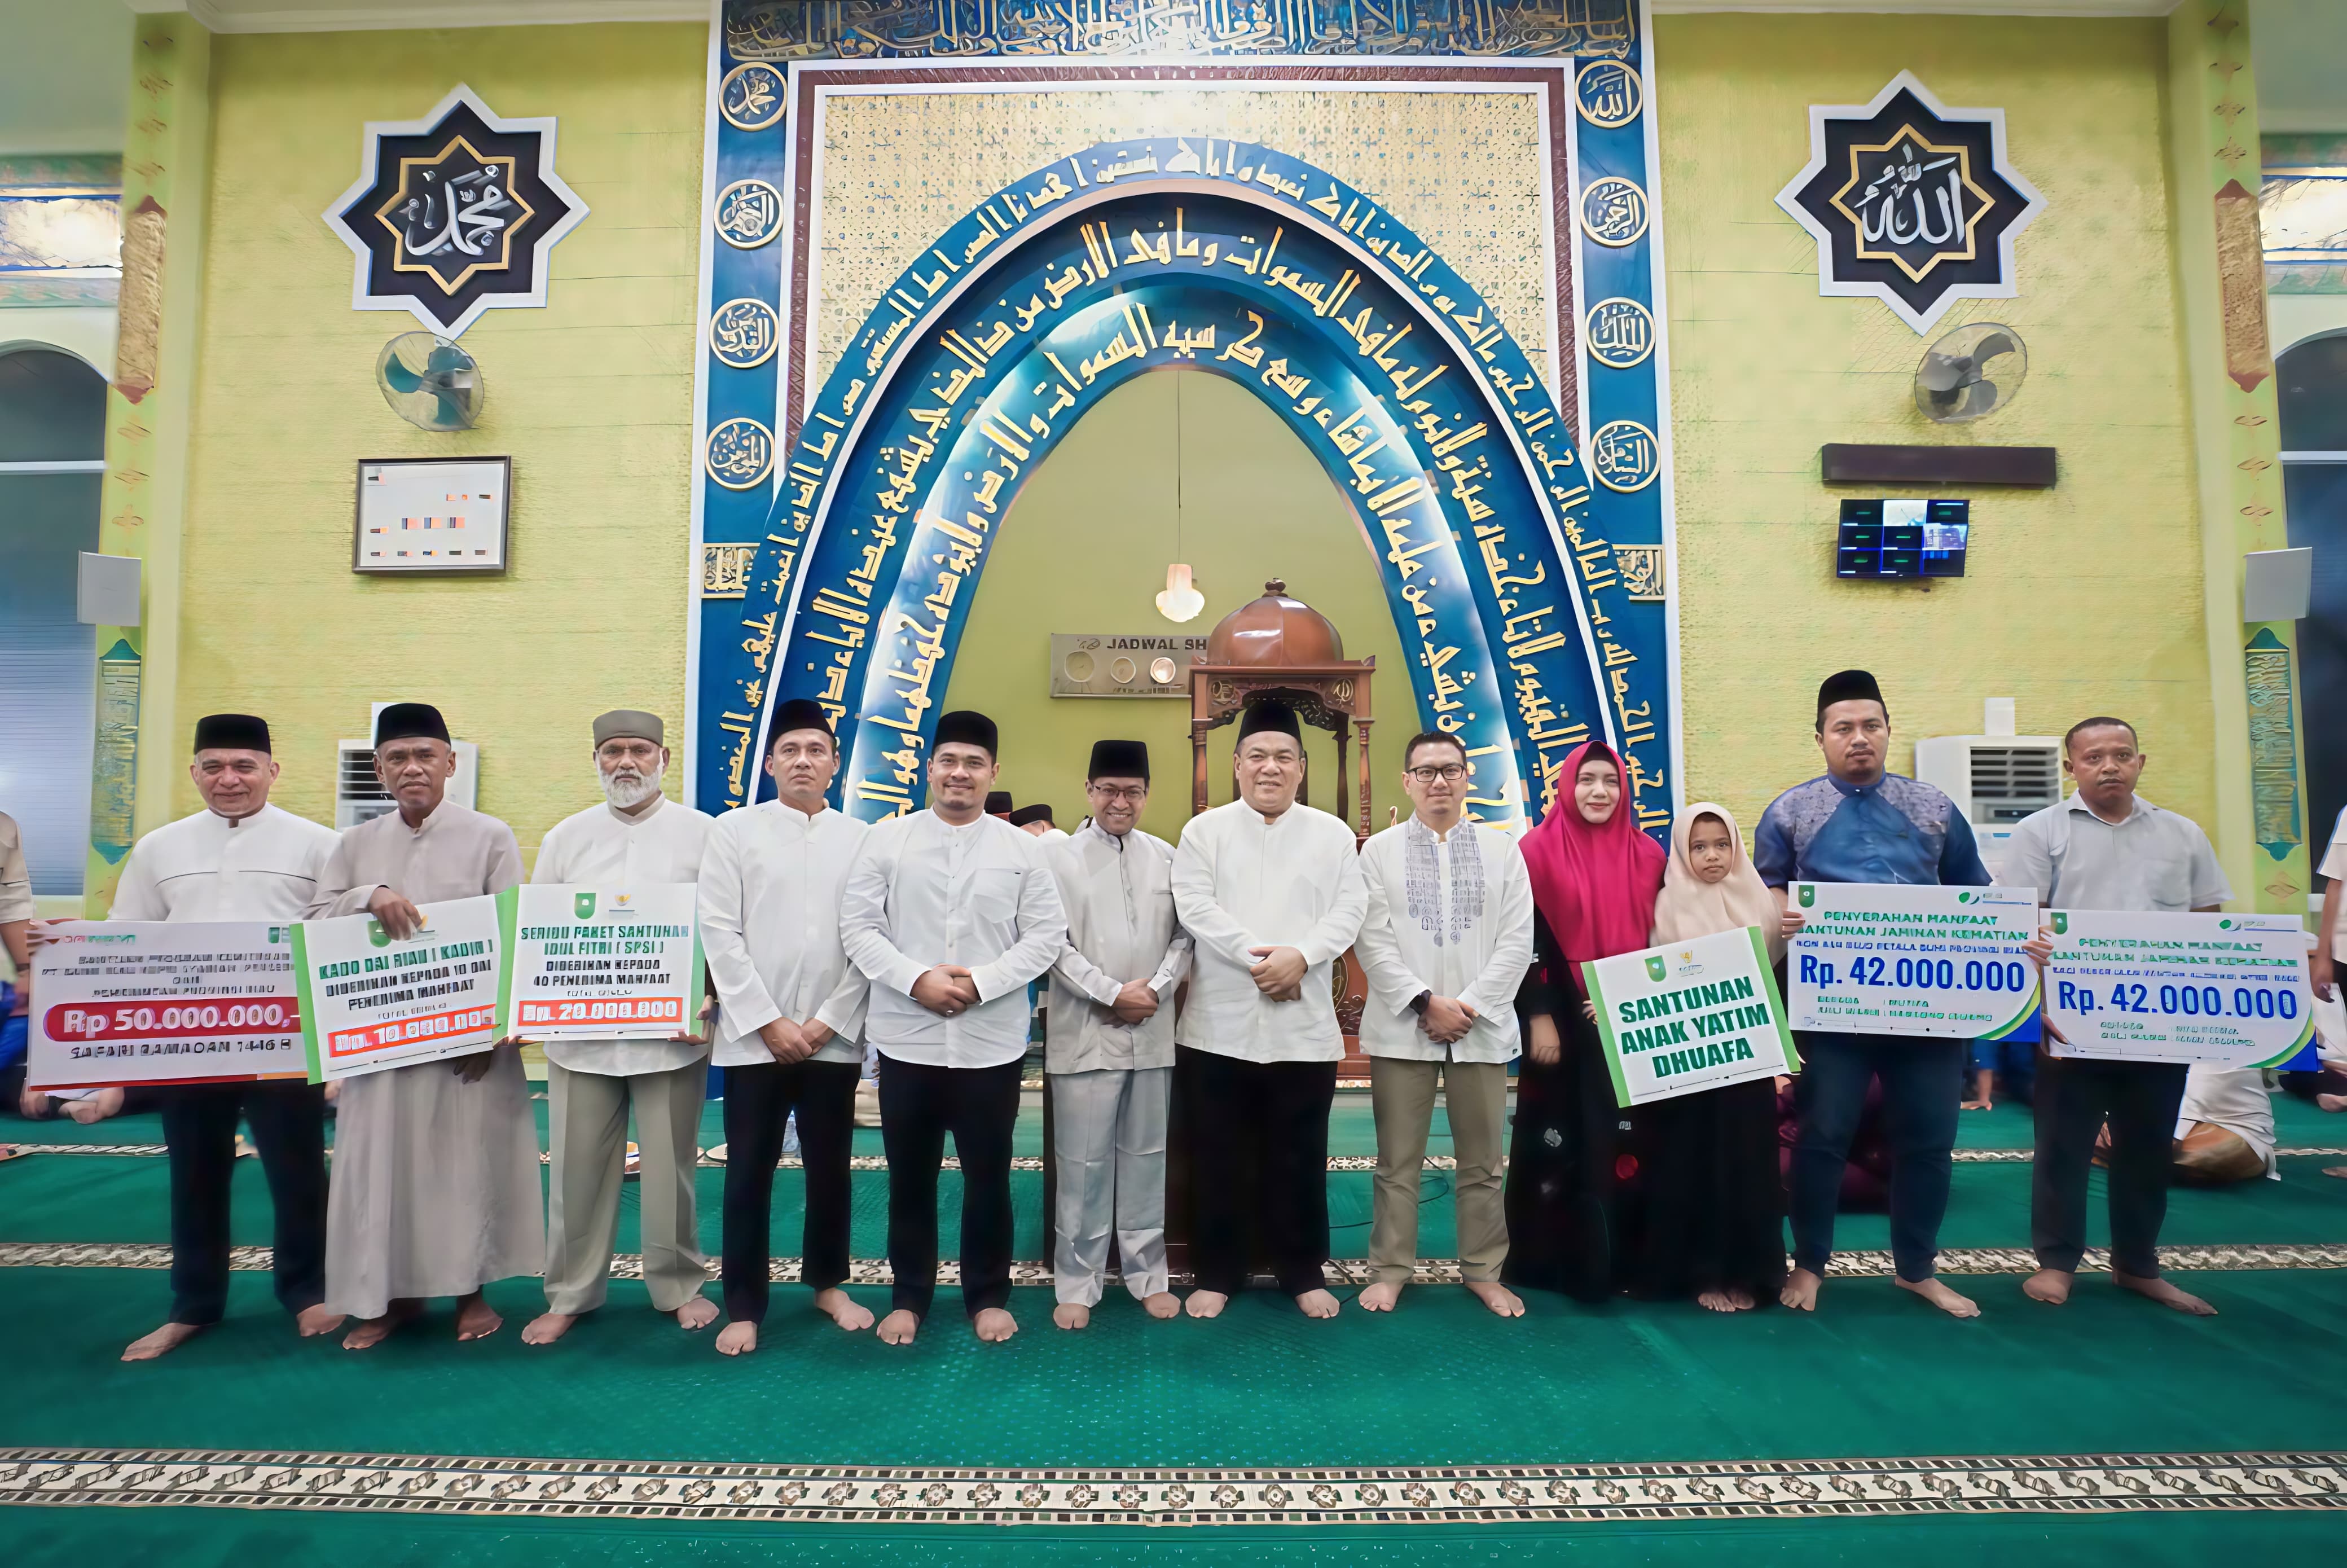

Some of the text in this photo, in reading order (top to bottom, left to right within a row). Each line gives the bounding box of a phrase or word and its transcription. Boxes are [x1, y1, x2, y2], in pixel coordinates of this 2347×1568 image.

[405, 165, 504, 256] محمد
[1854, 143, 1965, 244] الله
[1107, 639, 1178, 650] JADWAL
[1800, 954, 1842, 989] Rp.
[1850, 956, 2024, 992] 42.000.000
[1618, 976, 1755, 1024] SANTUNAN
[2058, 981, 2297, 1020] Rp. 42.000.000
[1620, 1003, 1770, 1055] ANAK YATIM
[1651, 1037, 1755, 1078] DHUAFA
